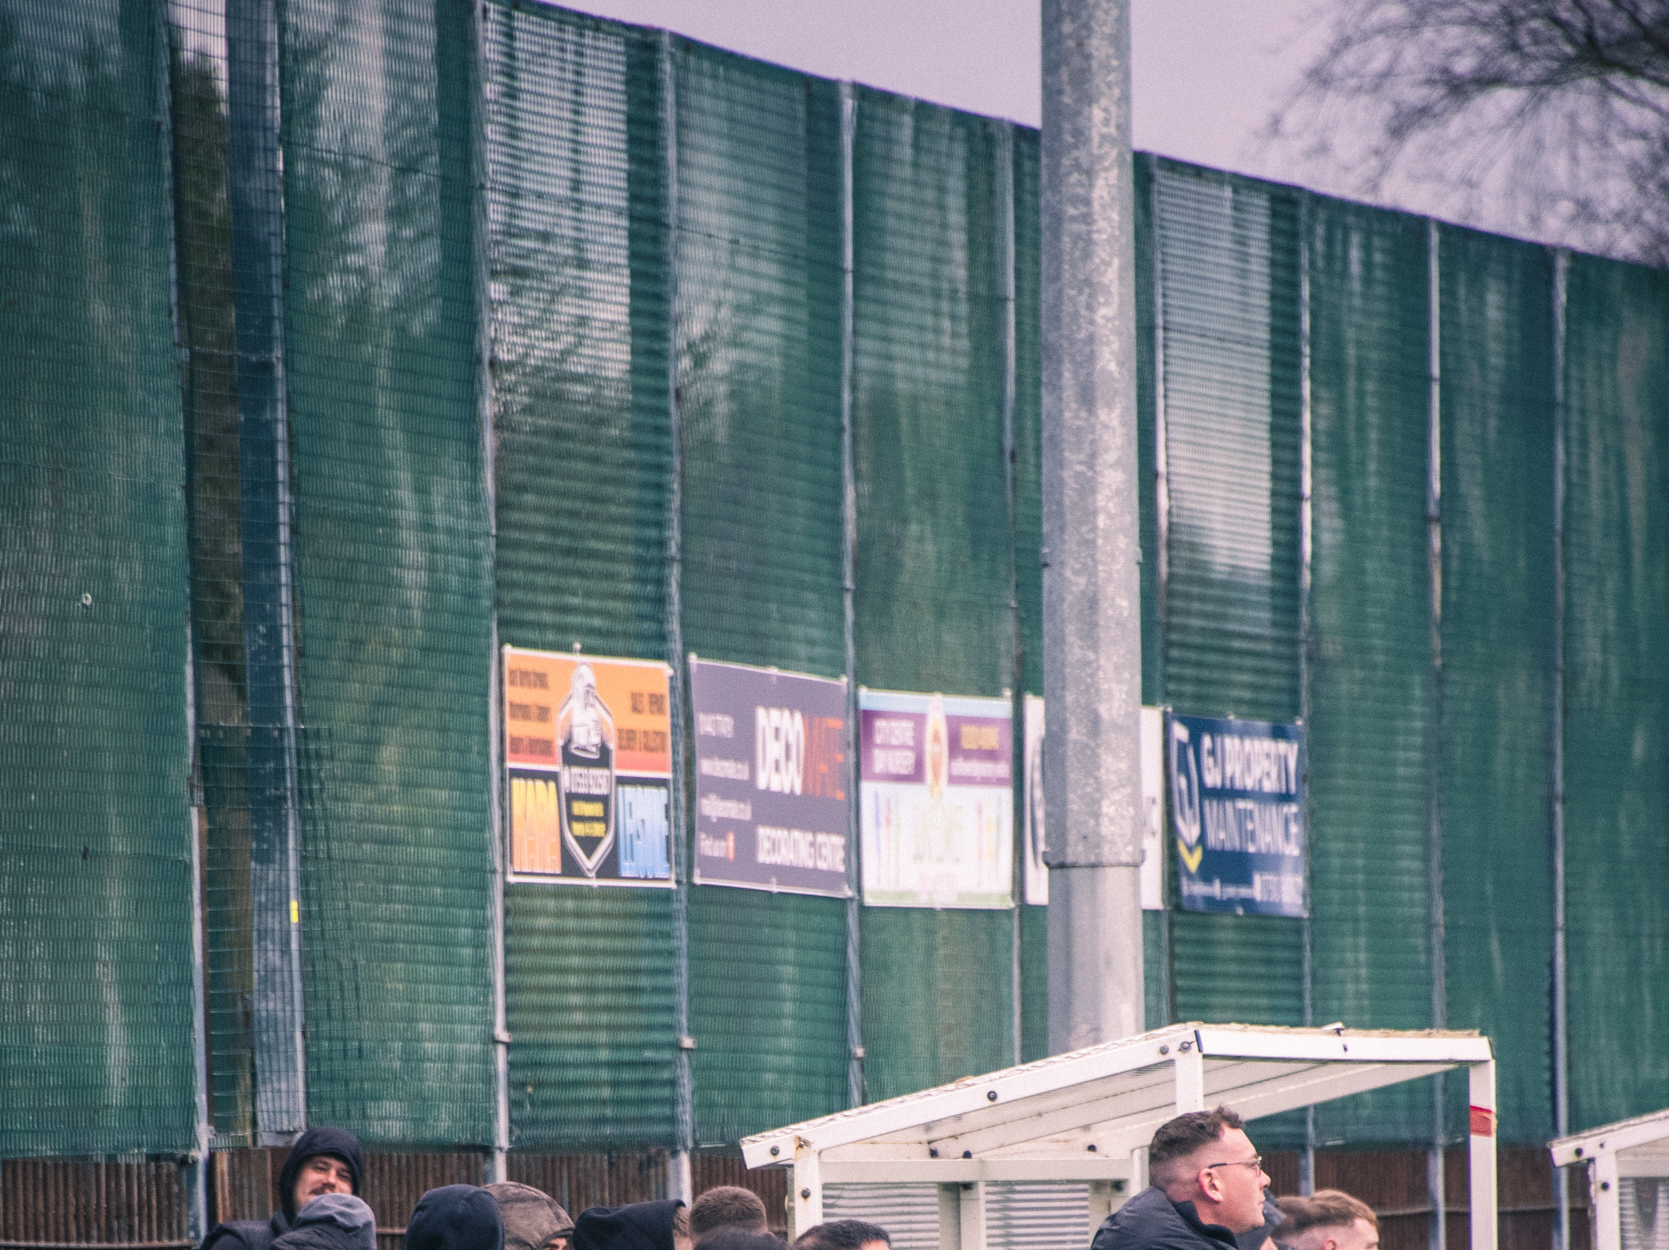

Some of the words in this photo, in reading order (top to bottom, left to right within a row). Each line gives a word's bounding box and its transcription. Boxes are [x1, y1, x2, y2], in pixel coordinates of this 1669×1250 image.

[1200, 733, 1222, 789] GJ
[1223, 734, 1299, 795] PROPERTY
[756, 825, 815, 868] DECORATING
[816, 832, 846, 873] CENTRE
[1202, 799, 1300, 856] MAINTENANCE
